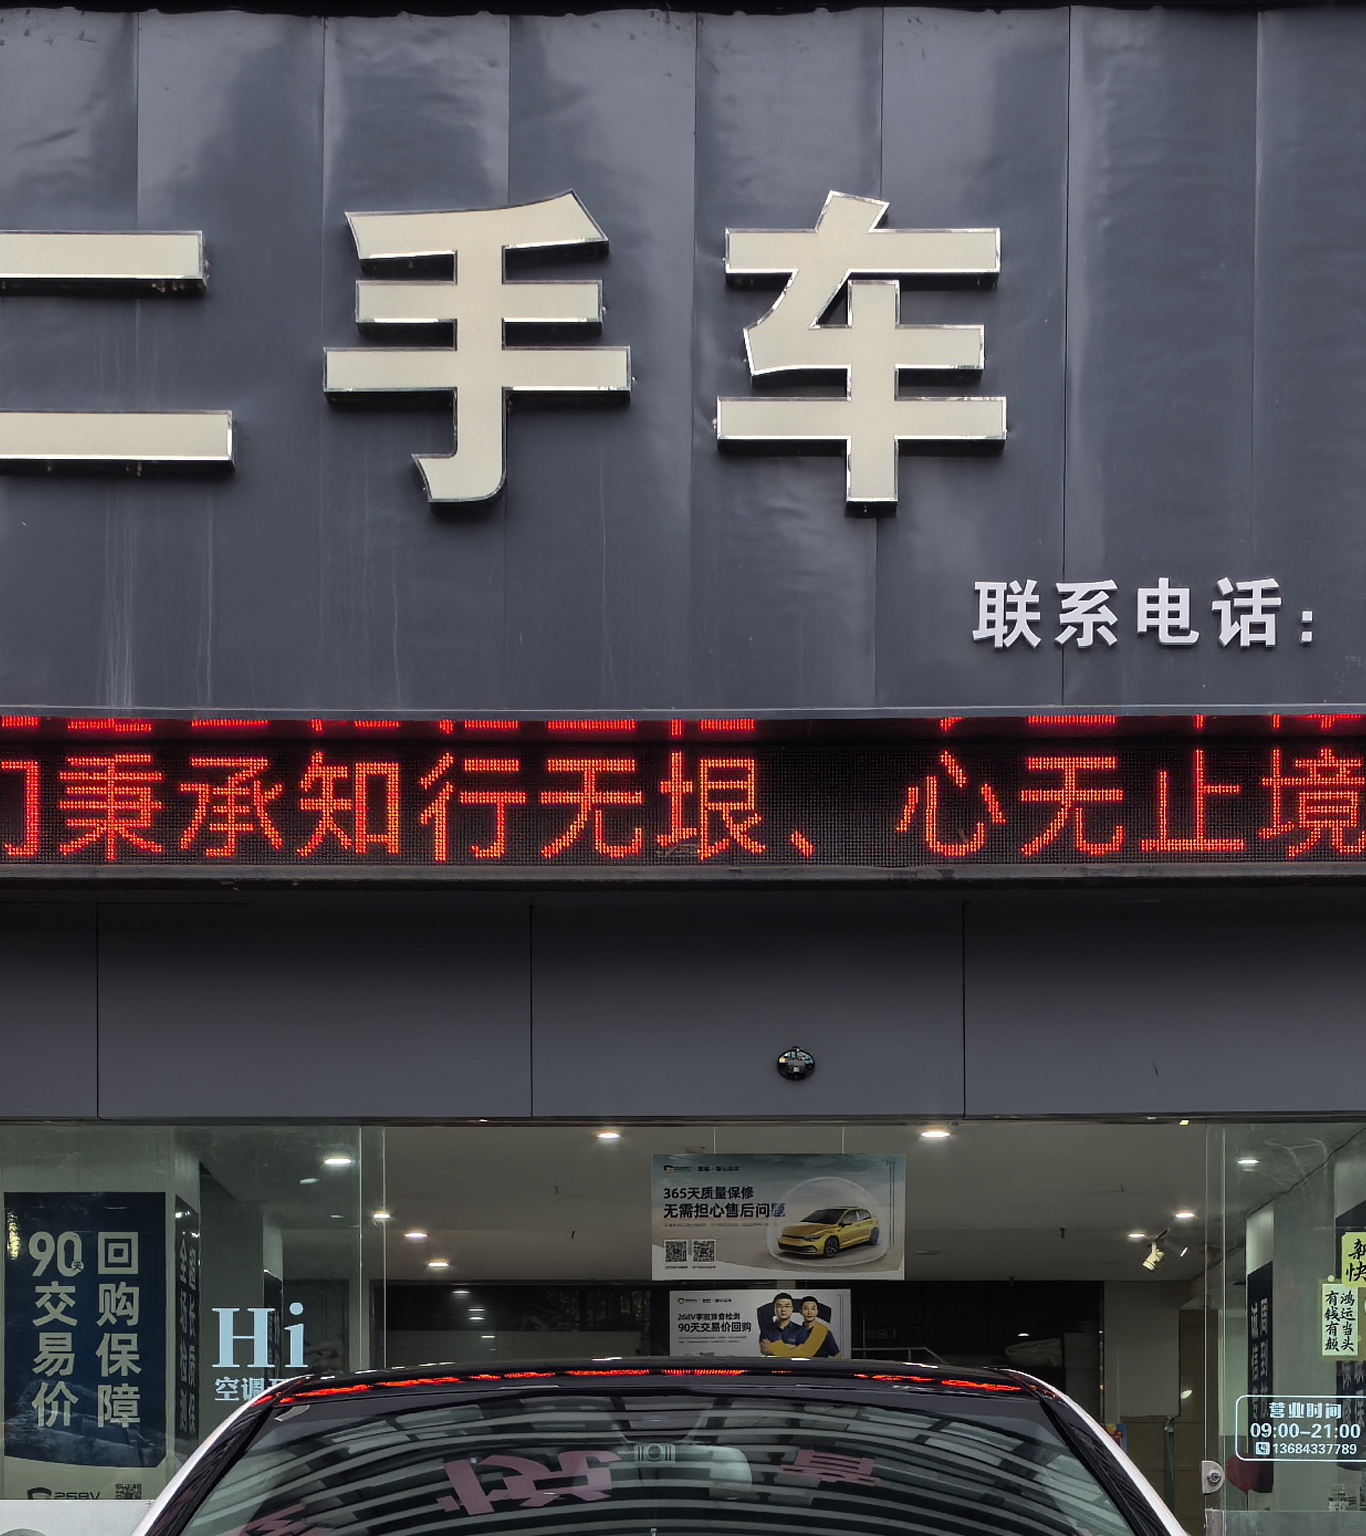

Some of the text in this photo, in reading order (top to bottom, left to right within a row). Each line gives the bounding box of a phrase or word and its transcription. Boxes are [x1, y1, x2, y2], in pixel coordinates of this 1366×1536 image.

[663, 1186, 754, 1200] 365天质量保修
[95, 1231, 142, 1428] 回购保障
[212, 1302, 309, 1367] Hi
[677, 1321, 752, 1334] 90天交易价回购
[215, 1376, 289, 1401] 空调
[1269, 1402, 1342, 1419] 营业时间
[1273, 1443, 1357, 1455] 13684337789
